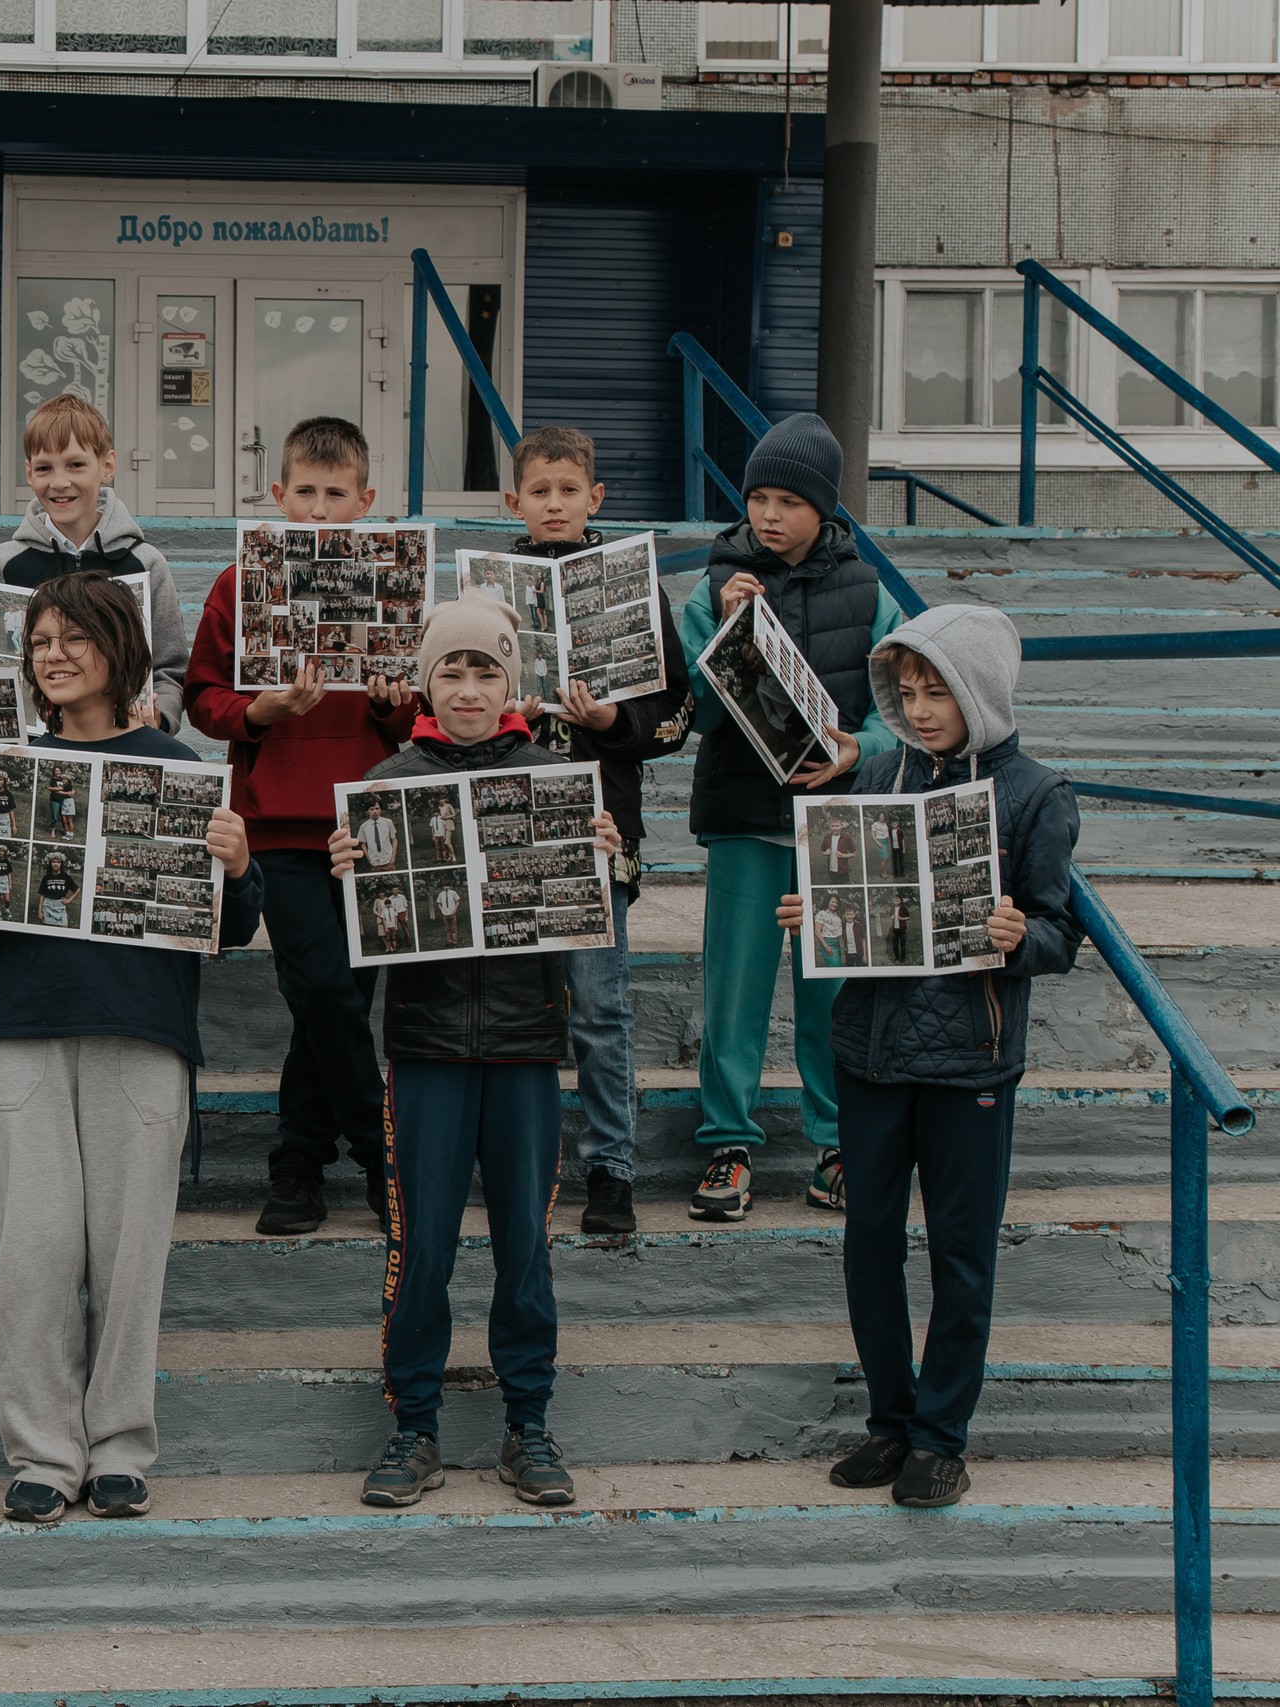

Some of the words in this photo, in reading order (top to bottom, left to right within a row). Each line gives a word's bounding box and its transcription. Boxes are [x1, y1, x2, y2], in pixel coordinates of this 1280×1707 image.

[116, 215, 203, 247] Добро
[212, 215, 390, 244] пожаловать!
[387, 1178, 402, 1242] MESSI
[383, 1249, 401, 1302] NETO
